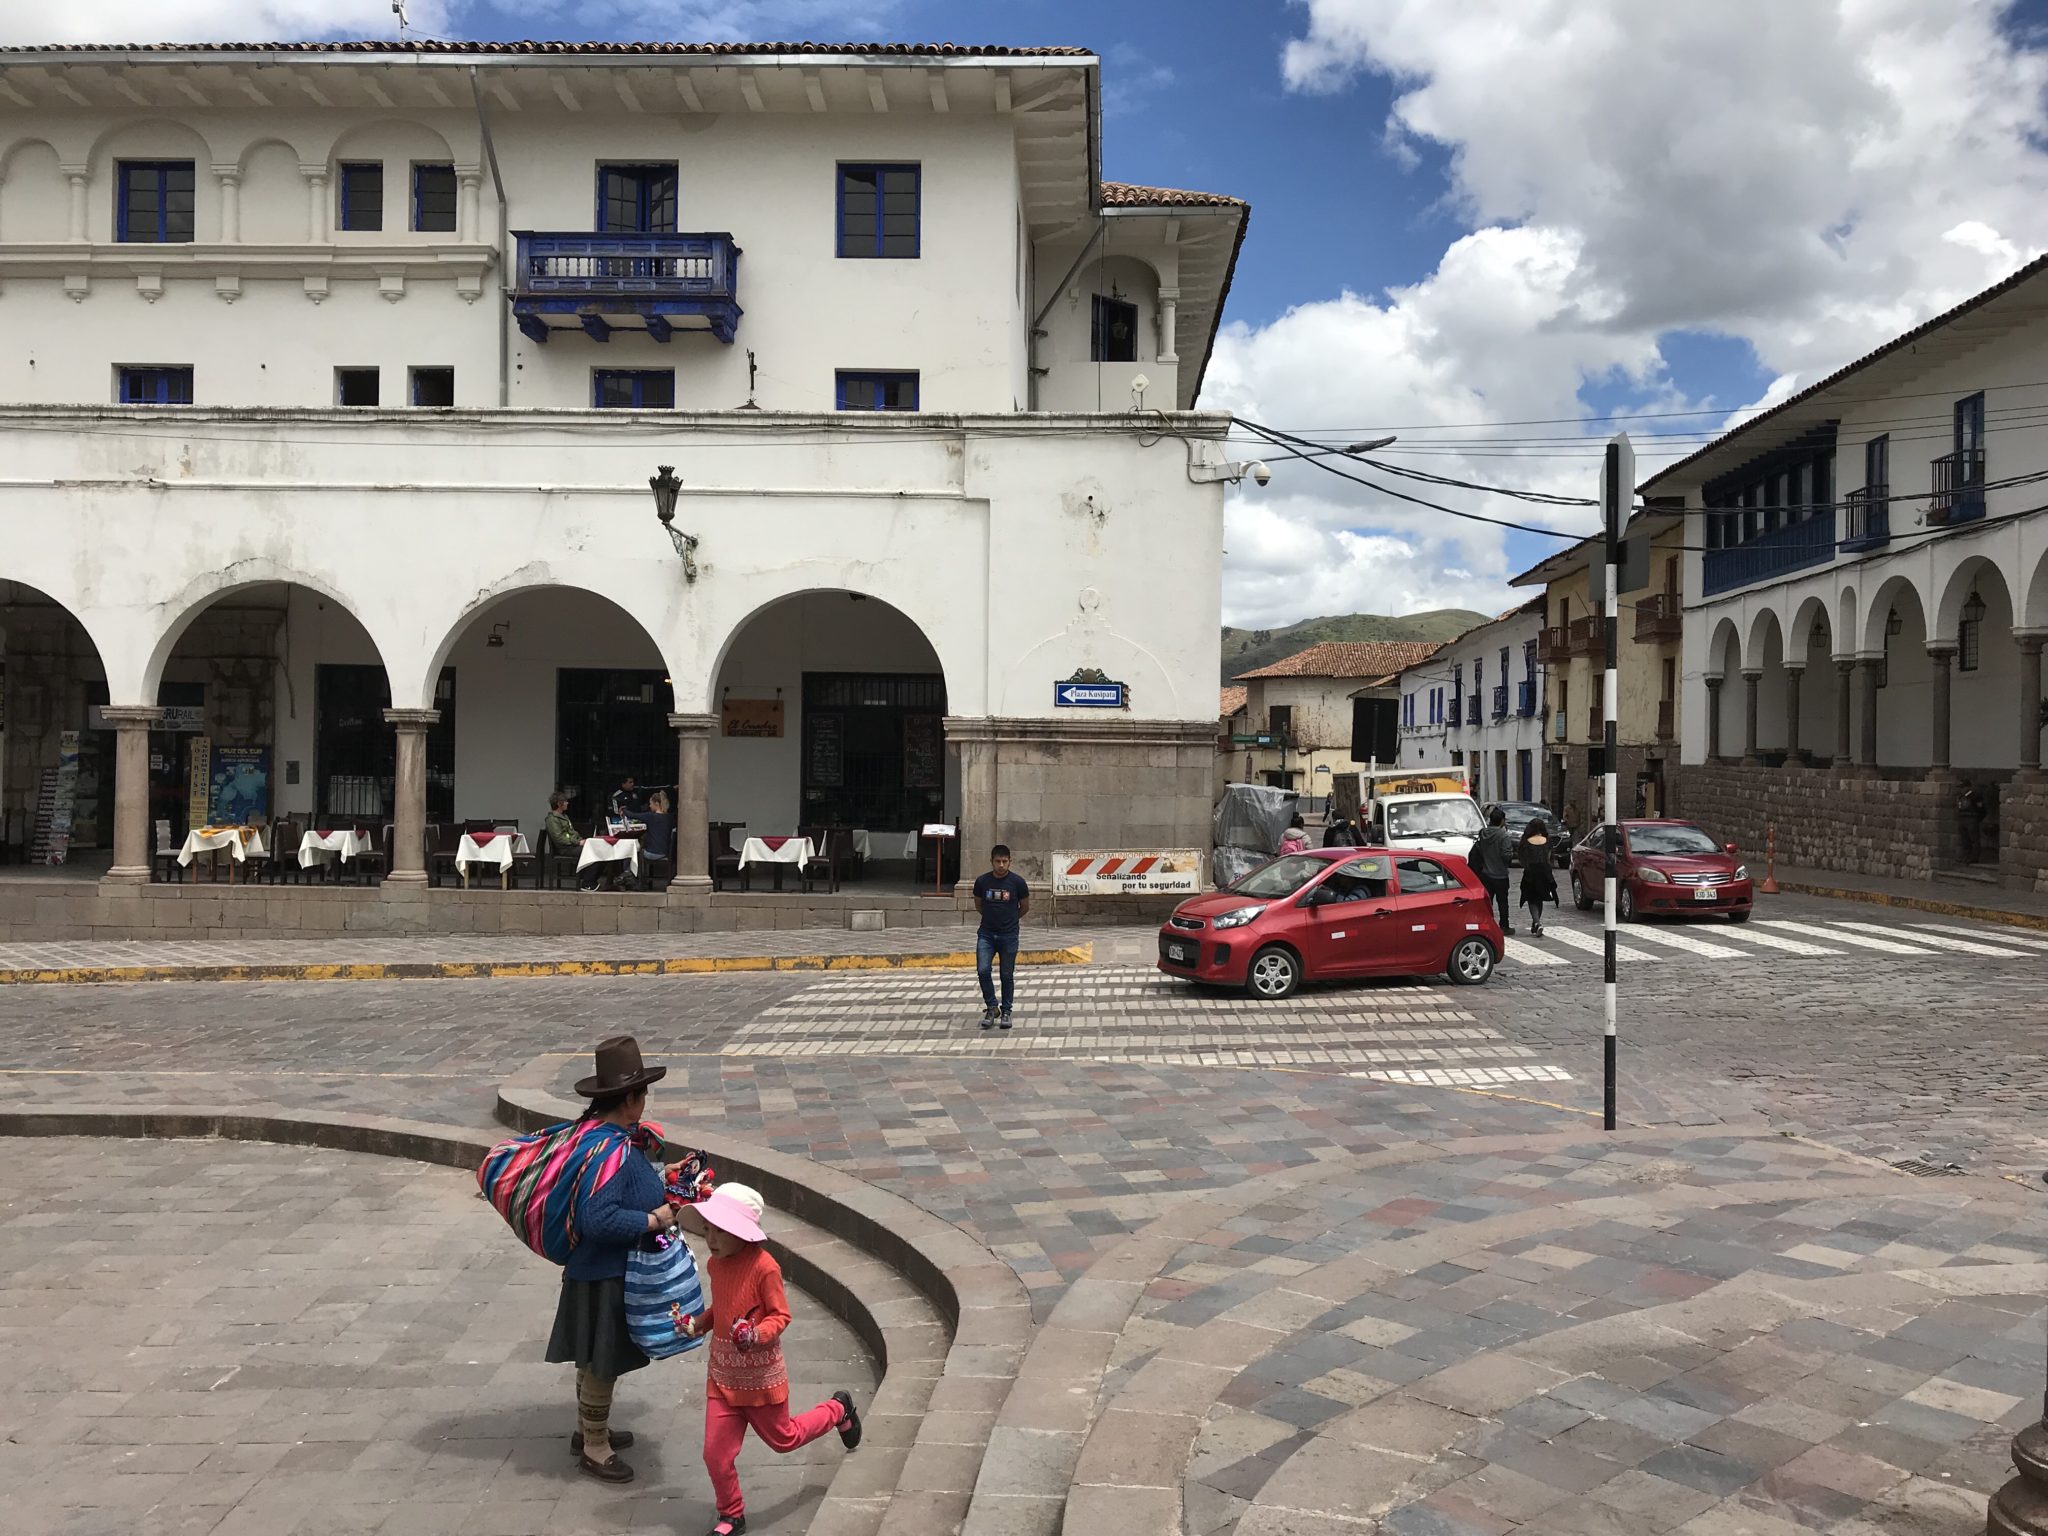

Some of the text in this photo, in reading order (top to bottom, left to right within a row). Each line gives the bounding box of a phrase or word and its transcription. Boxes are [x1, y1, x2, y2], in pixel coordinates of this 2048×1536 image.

[1071, 690, 1115, 699] Plaza Kusipata
[728, 719, 739, 728] El
[1397, 785, 1431, 793] CRISTAL
[1056, 883, 1088, 891] CUSCO
[1122, 882, 1136, 891] por
[1149, 881, 1191, 891] seguridad
